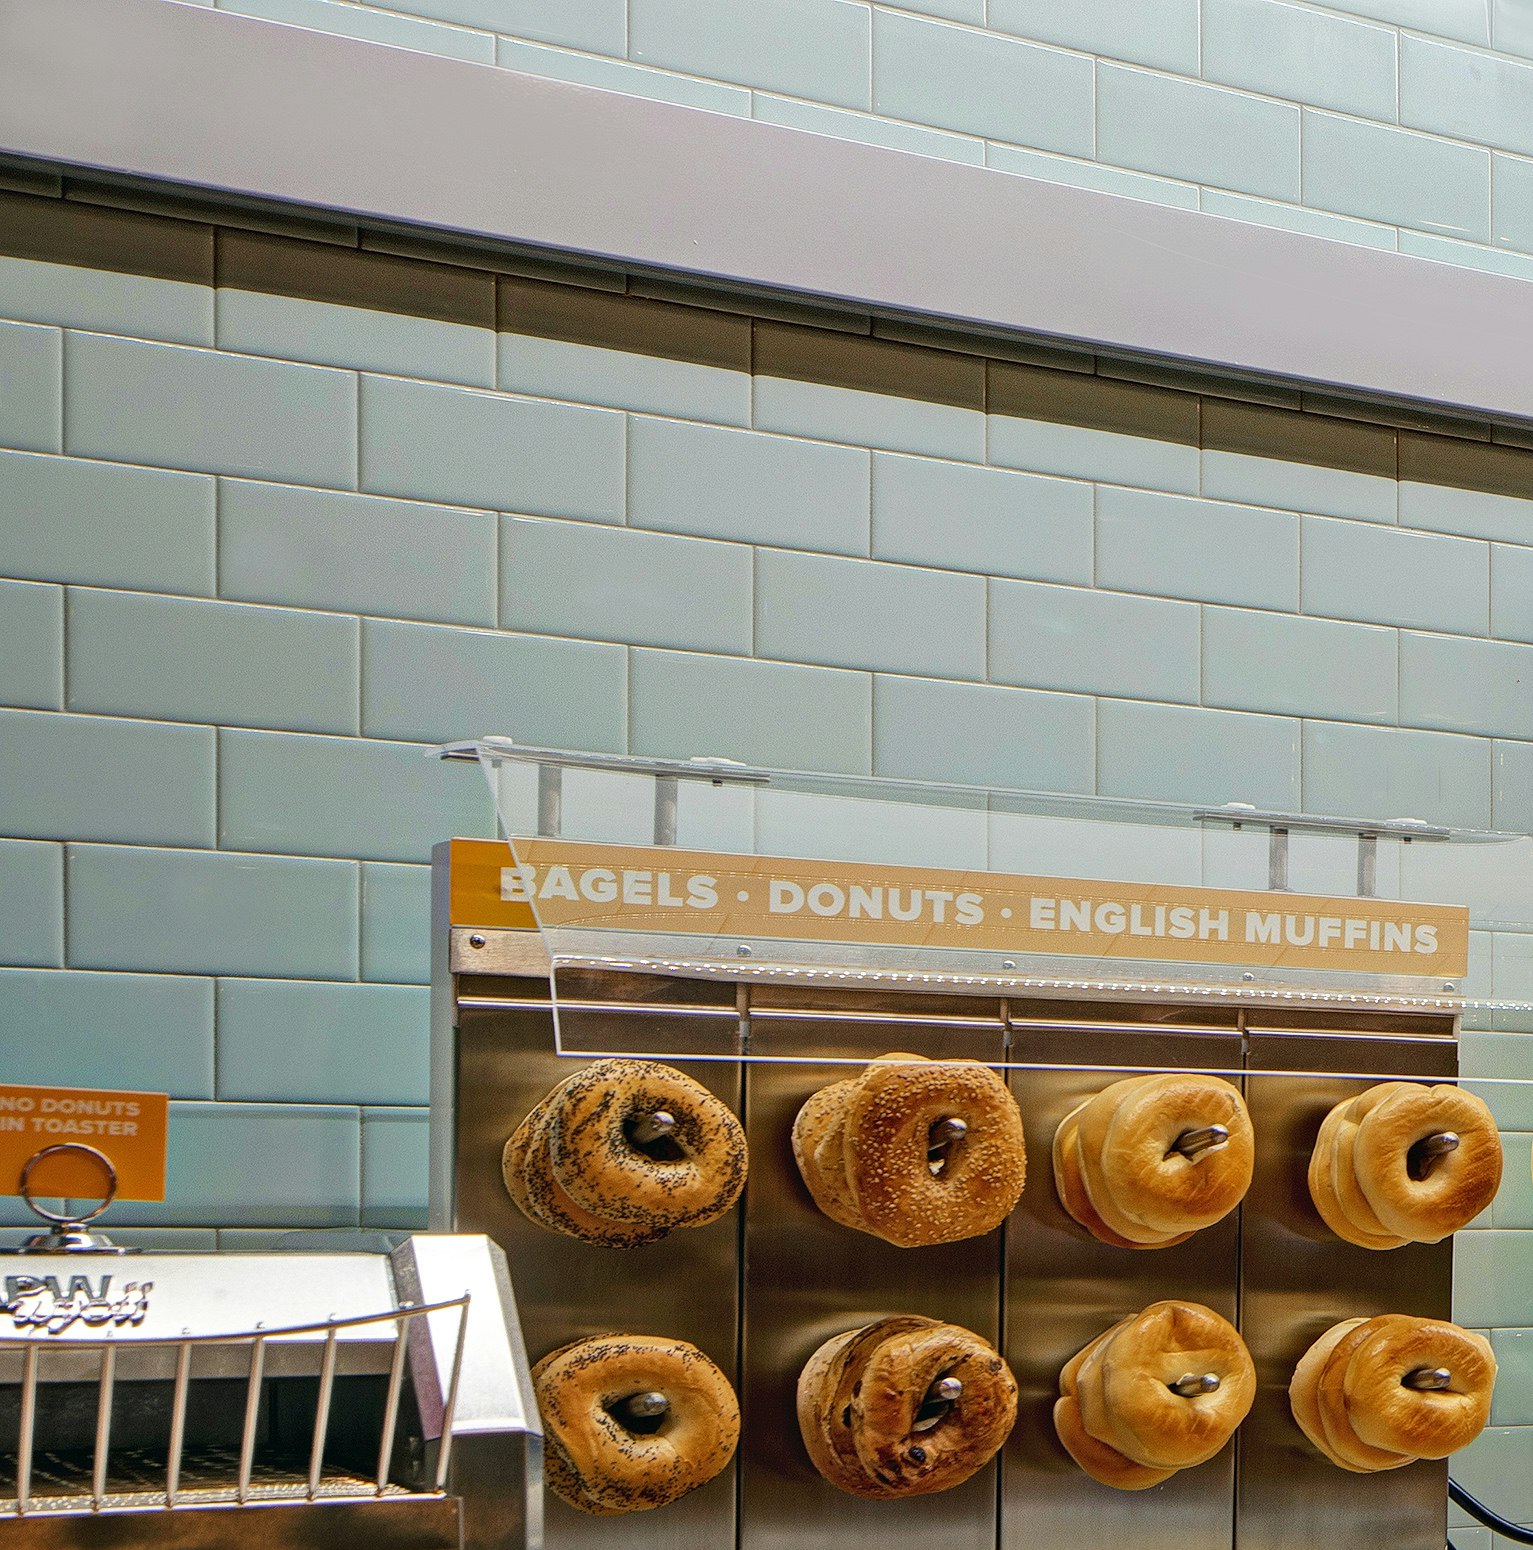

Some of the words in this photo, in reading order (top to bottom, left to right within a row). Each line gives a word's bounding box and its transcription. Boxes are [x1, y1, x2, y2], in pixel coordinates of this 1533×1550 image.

[500, 866, 718, 909] BAGELS
[768, 880, 985, 925] DONUTS
[1029, 897, 1229, 941] ENGLISH
[1245, 911, 1439, 954] MUFFINS
[0, 1096, 36, 1113] NO
[40, 1098, 141, 1117] DONUTS
[0, 1116, 25, 1132] IN
[32, 1117, 138, 1137] TOASTER
[2, 1274, 113, 1303] PW
